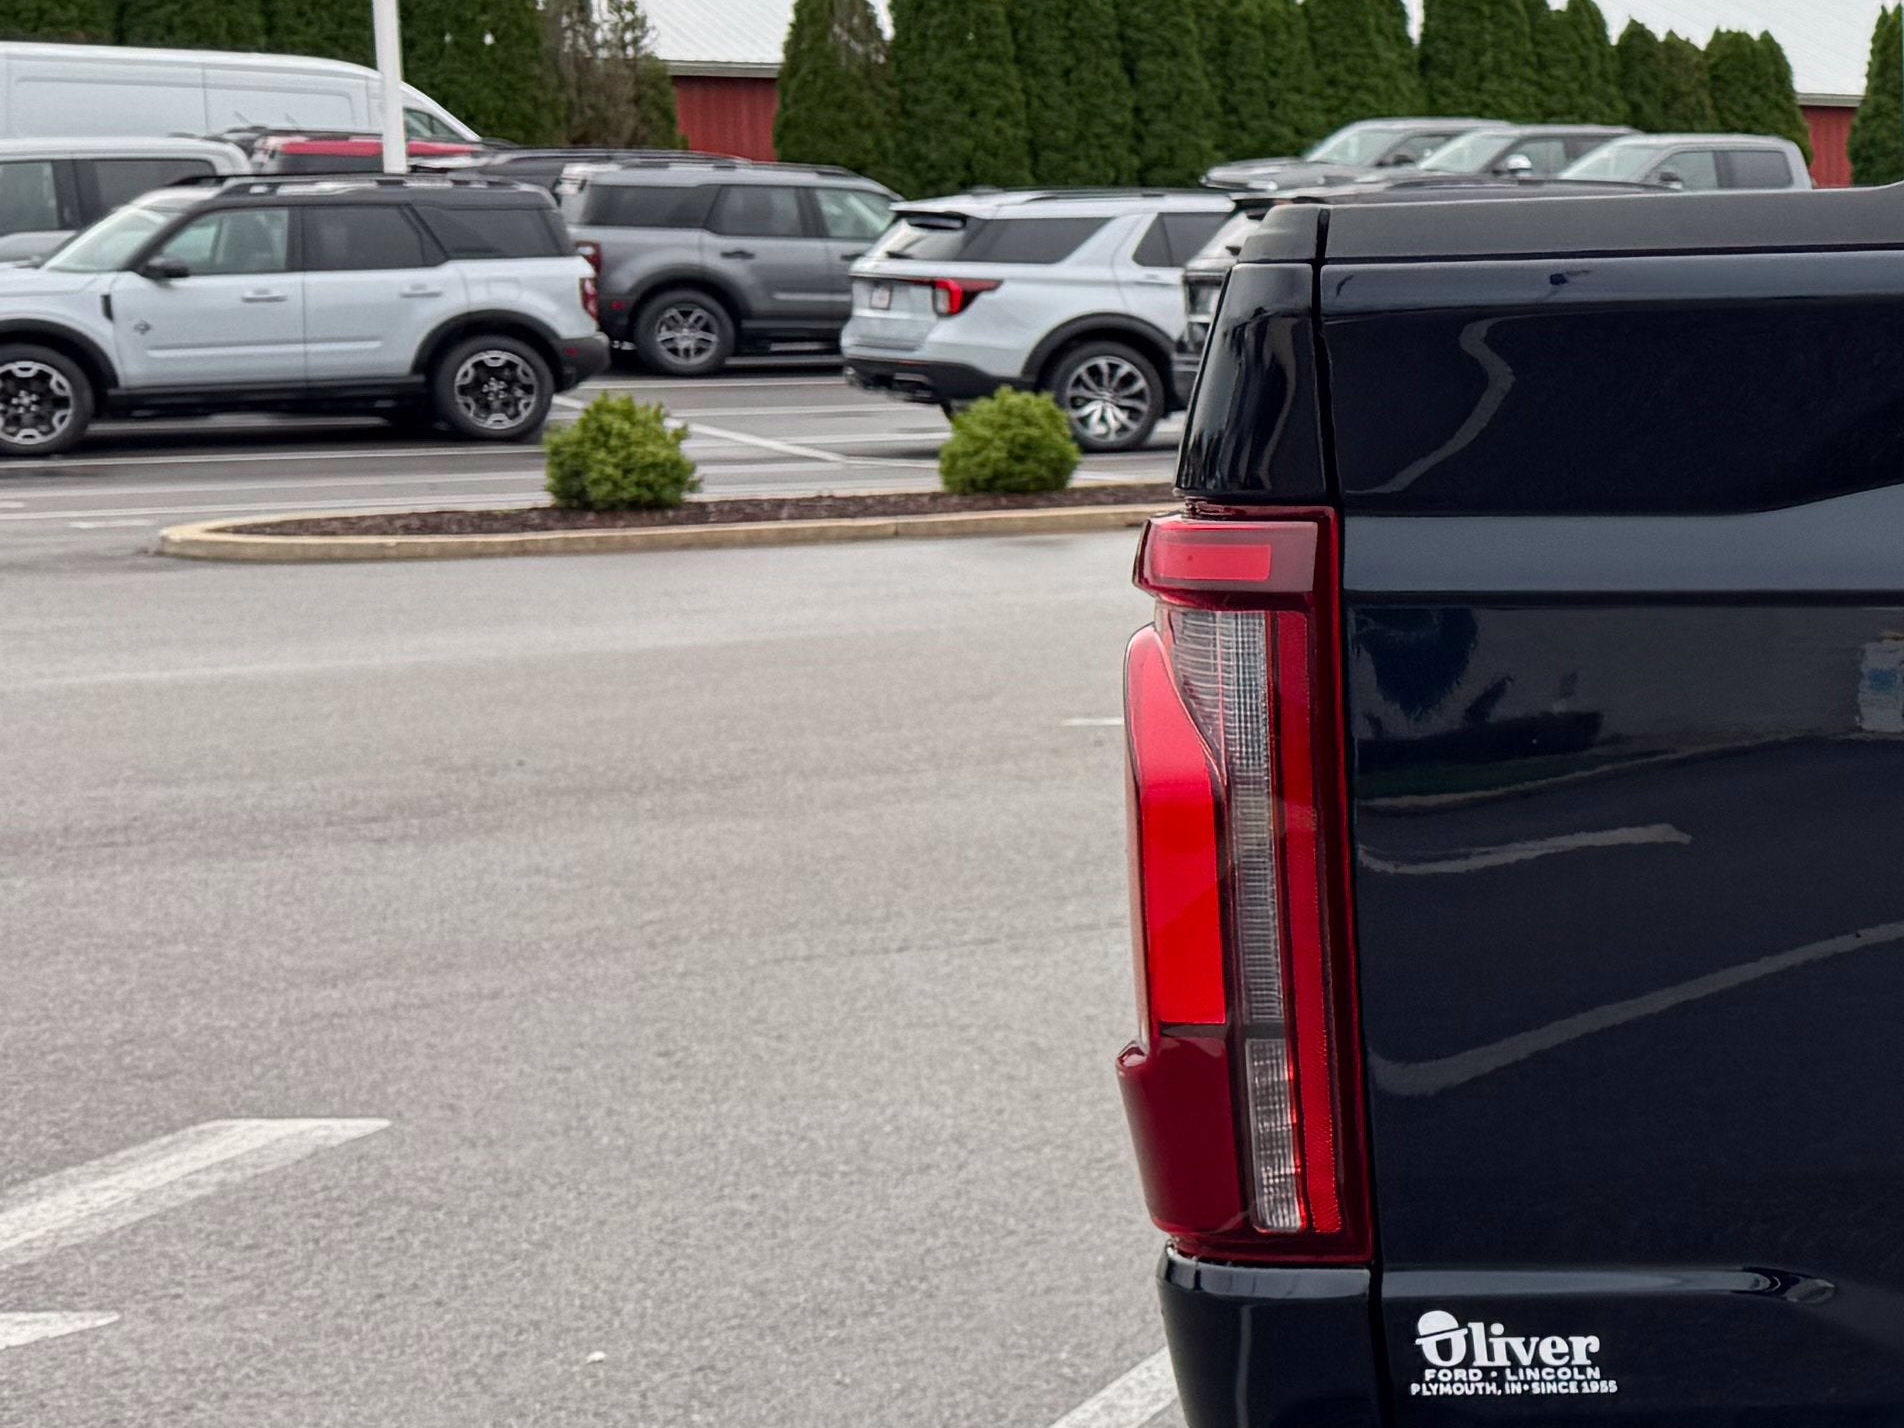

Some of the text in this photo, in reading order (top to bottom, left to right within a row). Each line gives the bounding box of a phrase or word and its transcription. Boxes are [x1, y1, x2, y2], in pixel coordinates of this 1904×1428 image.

[1415, 1310, 1600, 1367] Oliver
[1424, 1366, 1601, 1382] FORD LINCOLN
[1410, 1382, 1502, 1396] PLYMOUTH,
